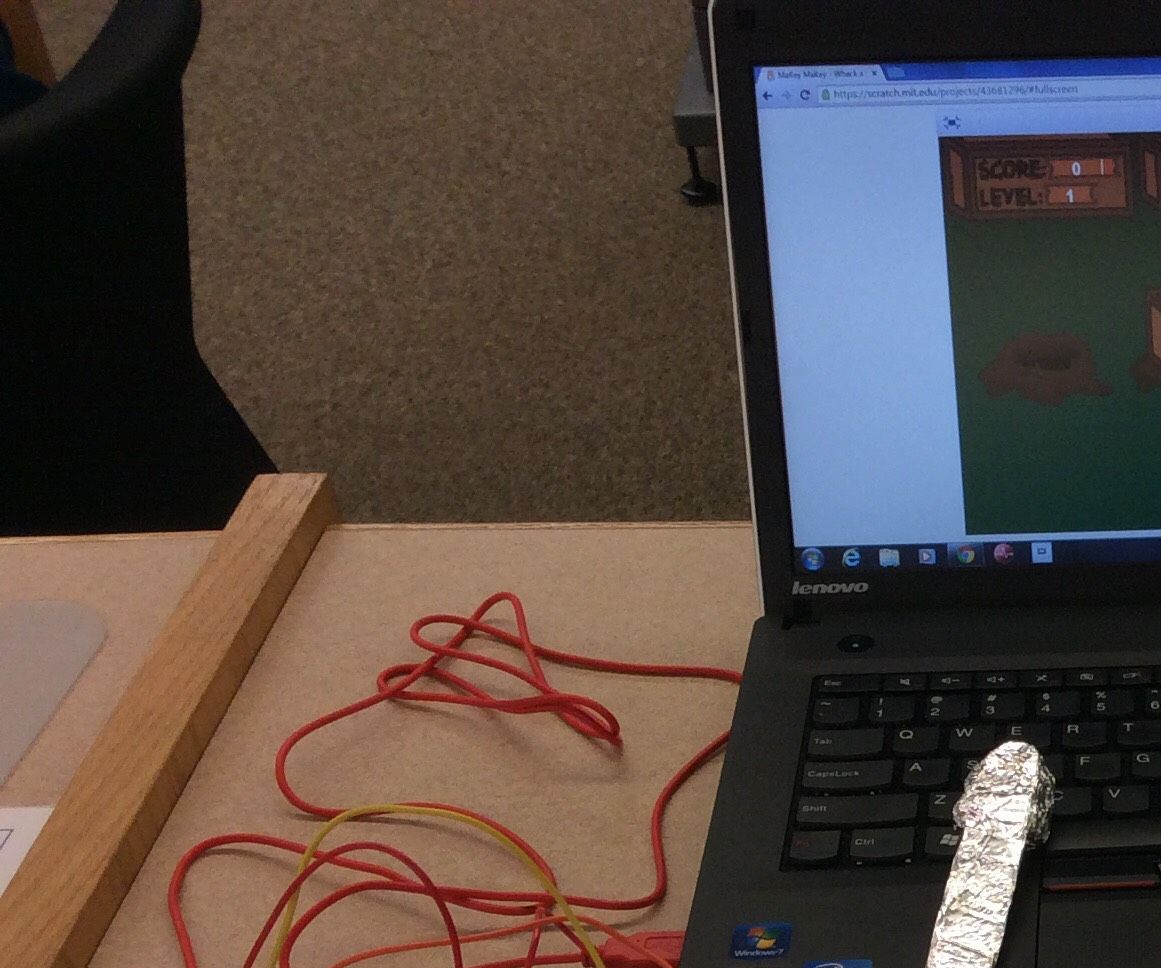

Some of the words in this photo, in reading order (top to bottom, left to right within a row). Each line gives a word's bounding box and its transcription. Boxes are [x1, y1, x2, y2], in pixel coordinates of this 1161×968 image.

[1071, 161, 1081, 176] 0
[1066, 188, 1074, 203] 1
[791, 581, 869, 595] lenovo
[985, 705, 996, 715] 3
[1096, 702, 1107, 710] 5
[1150, 700, 1160, 710] 6
[930, 707, 941, 717] 2
[1010, 725, 1023, 736] E
[1066, 724, 1080, 734] R
[1122, 722, 1134, 732] T
[899, 729, 914, 740] Q
[955, 727, 974, 738] W
[814, 737, 833, 745] Tab
[1079, 756, 1091, 766] F
[1136, 753, 1150, 763] G
[908, 761, 923, 772] A
[1107, 788, 1121, 799] V
[933, 794, 947, 805] Z
[854, 838, 875, 846] Ctrl
